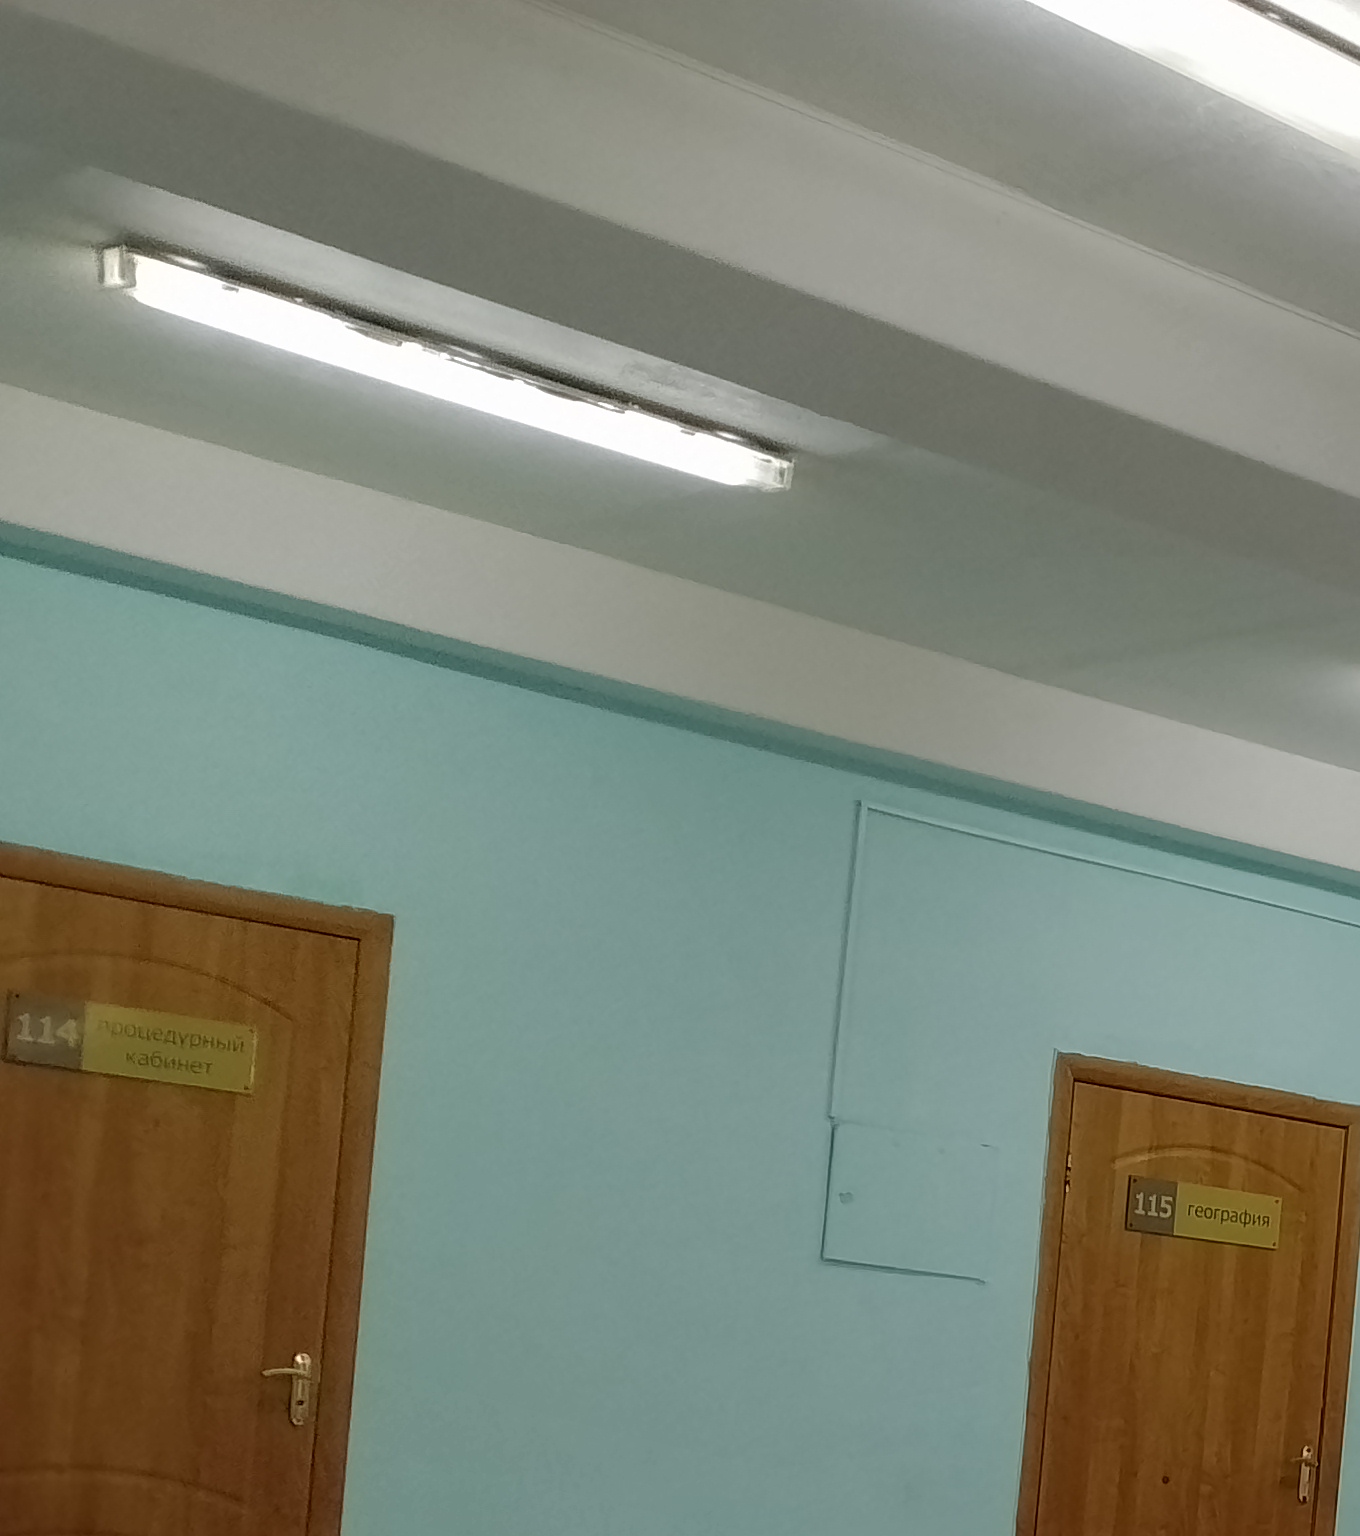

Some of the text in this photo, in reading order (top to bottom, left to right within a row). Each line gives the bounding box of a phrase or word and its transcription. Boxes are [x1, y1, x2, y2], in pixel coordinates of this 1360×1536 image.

[15, 1012, 79, 1048] 114
[125, 1050, 214, 1075] кабинет
[1133, 1191, 1174, 1219] 115
[1187, 1203, 1271, 1229] география
